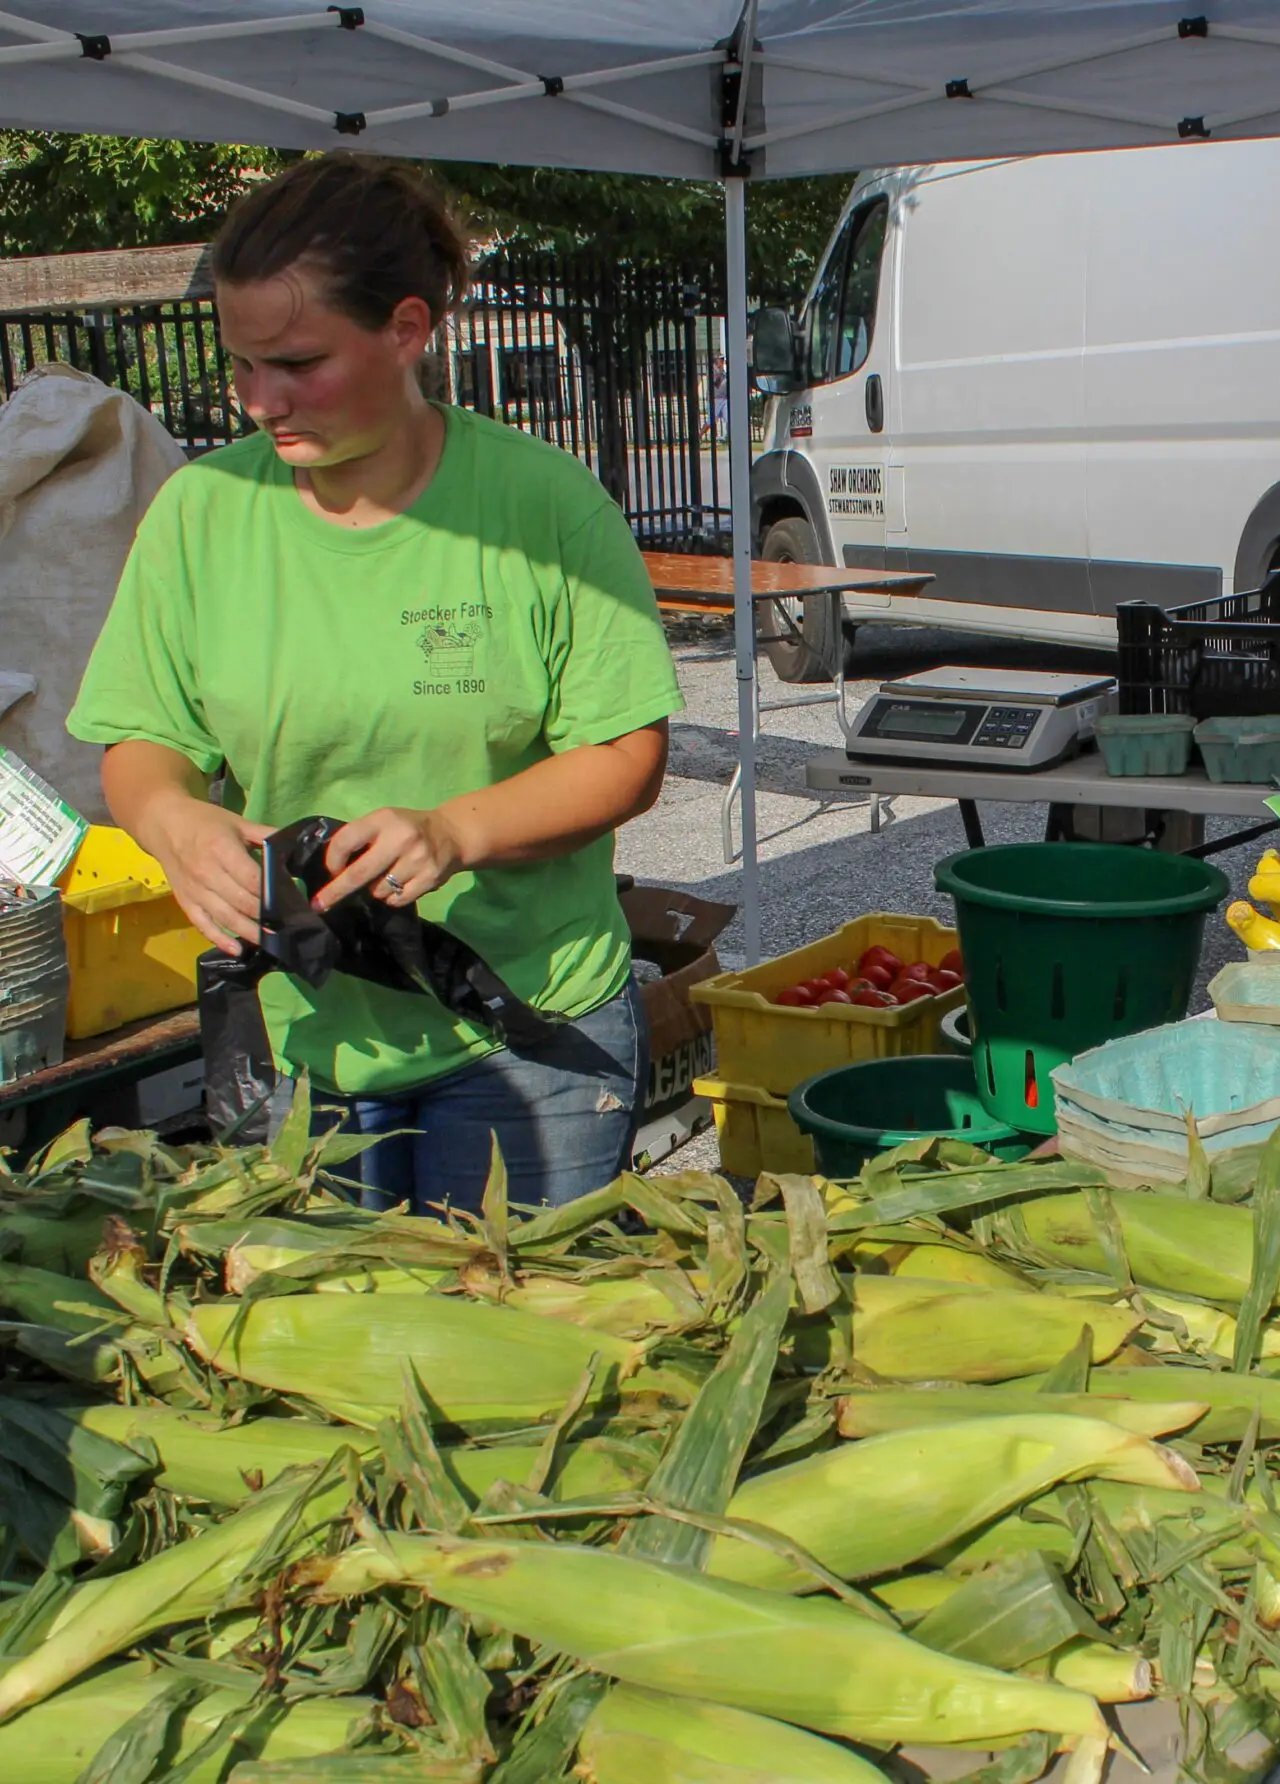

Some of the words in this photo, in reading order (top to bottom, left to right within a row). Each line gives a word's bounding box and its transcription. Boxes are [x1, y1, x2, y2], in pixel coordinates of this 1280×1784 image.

[829, 468, 847, 494] SHAW
[848, 468, 881, 494] ORCHARDS
[829, 498, 875, 518] STEWARTSTOWN,
[875, 500, 884, 515] PA
[400, 604, 457, 626] Stoecker
[412, 680, 451, 695] Since
[455, 679, 486, 694] 1890
[644, 1033, 710, 1108] EENS
